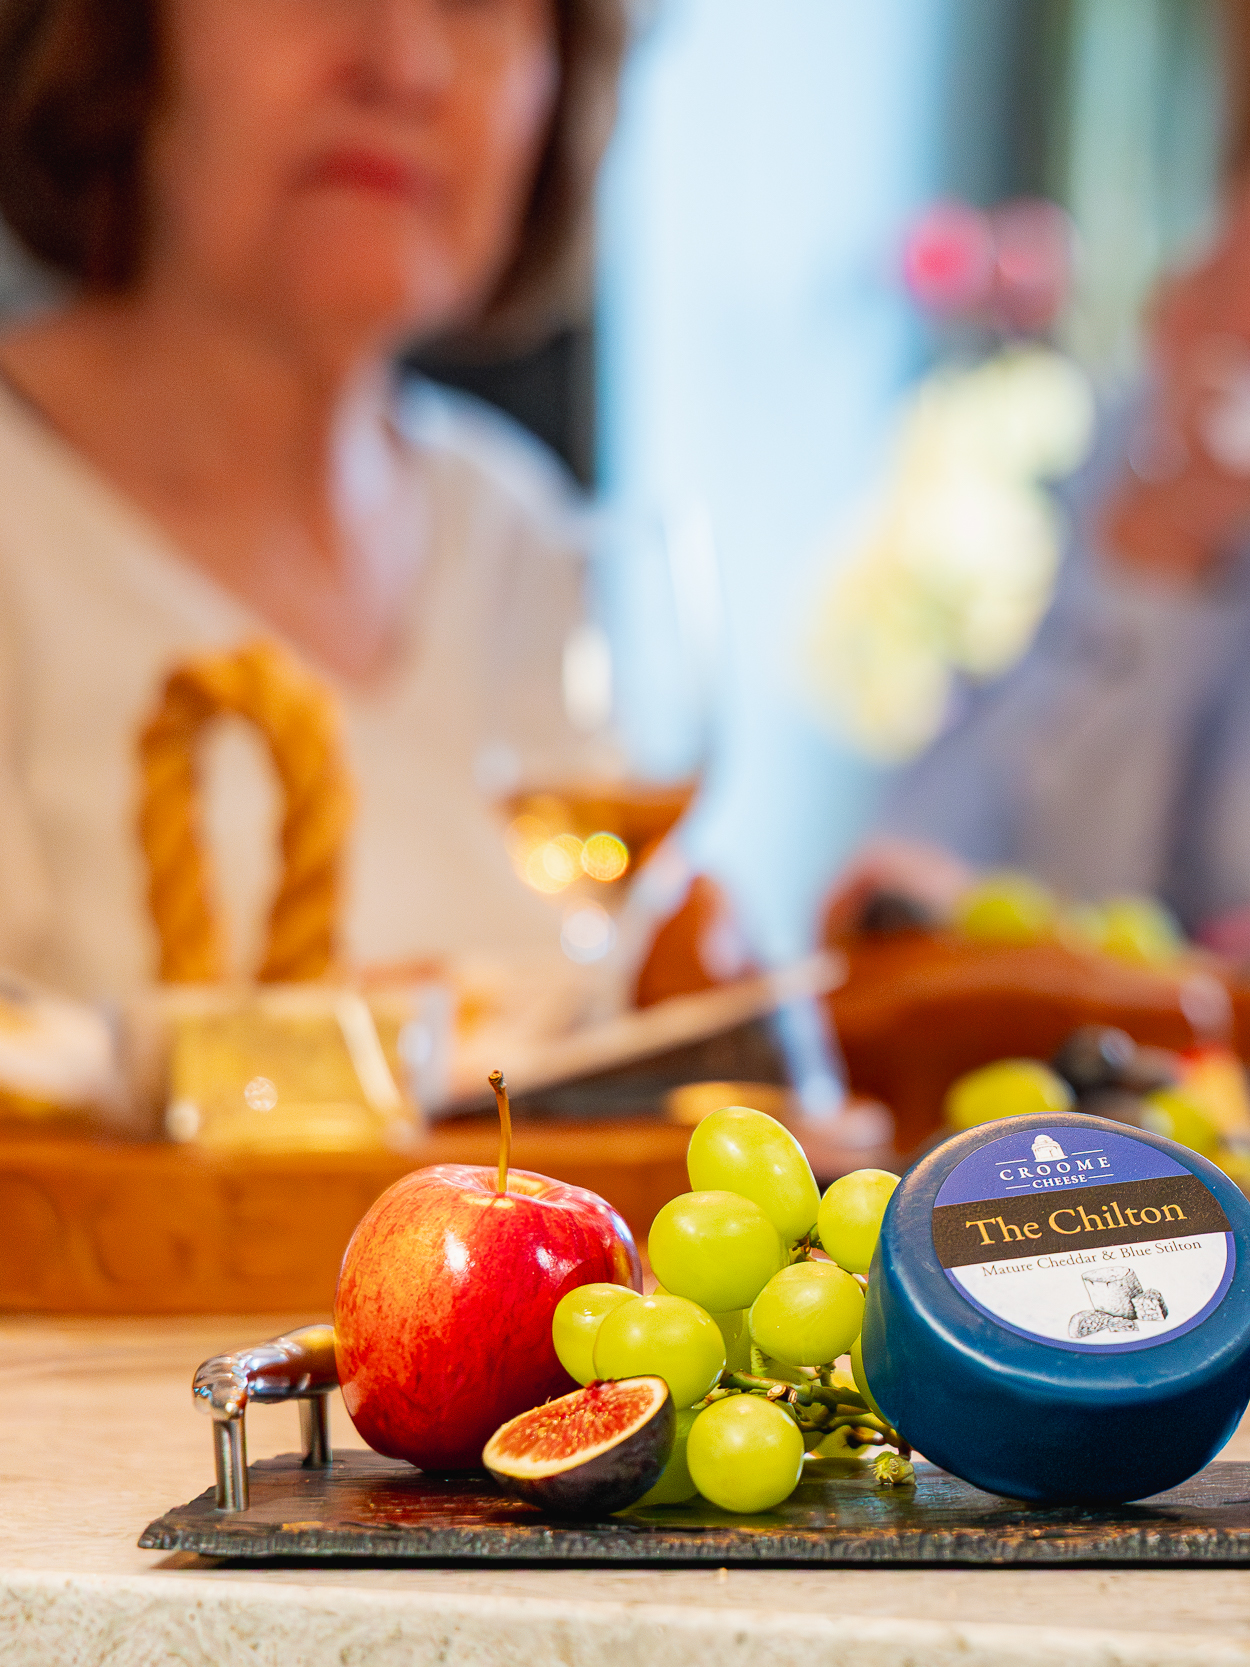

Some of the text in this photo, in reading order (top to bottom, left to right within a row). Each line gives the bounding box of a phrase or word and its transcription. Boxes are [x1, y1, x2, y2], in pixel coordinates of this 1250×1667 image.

[999, 1156, 1111, 1182] CROOME
[1032, 1174, 1088, 1189] CHEESE
[965, 1201, 1187, 1246] The Chilton
[982, 1238, 1203, 1277] Mature Cheddar & Blue Stilton
